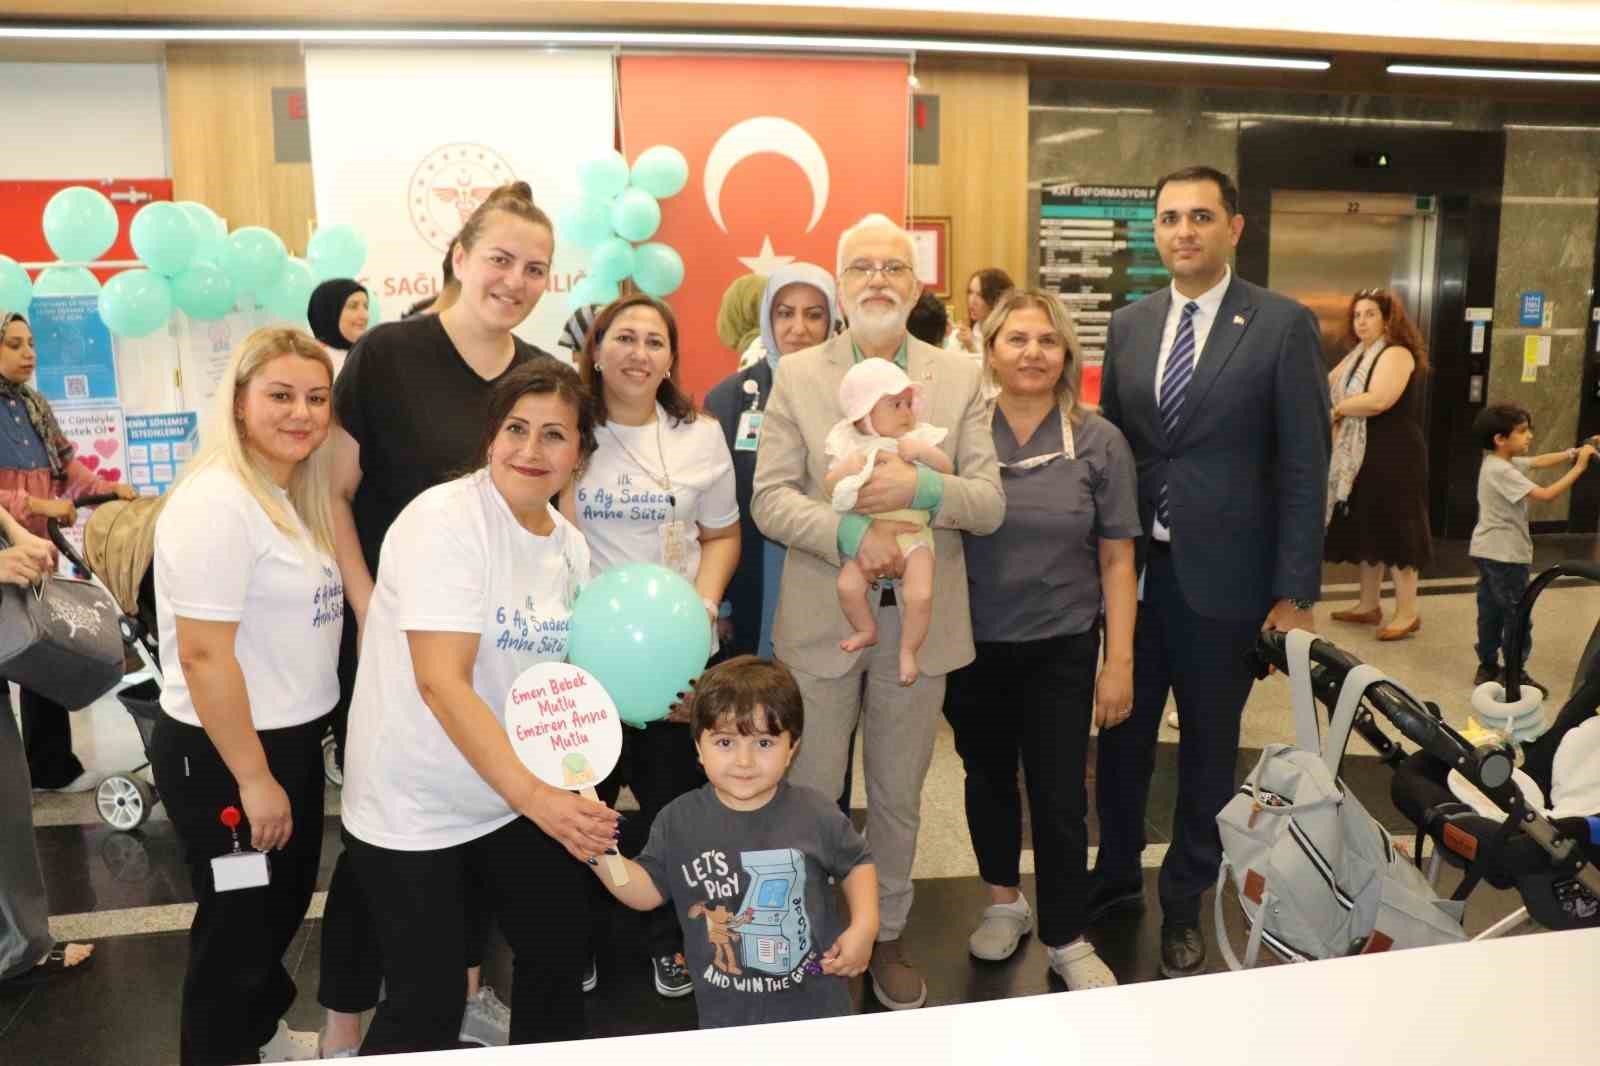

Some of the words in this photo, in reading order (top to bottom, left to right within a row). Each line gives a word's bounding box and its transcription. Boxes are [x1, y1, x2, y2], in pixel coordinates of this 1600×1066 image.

[384, 271, 437, 296] SAĞL
[63, 425, 91, 436] estek
[578, 488, 586, 502] 6
[594, 488, 613, 510] Ay
[583, 504, 624, 520] Anne
[630, 506, 666, 521] Sütü
[496, 606, 506, 625] 6
[496, 630, 534, 652] Anne
[511, 686, 547, 705] Emen
[548, 672, 588, 695] Bebek
[537, 696, 577, 717] Mutlu
[515, 719, 568, 741] Emziren
[571, 709, 608, 728] Anne
[549, 731, 589, 751] Mutlu
[681, 849, 729, 888] LET'S
[703, 964, 730, 988] AND
[733, 976, 764, 993] WIN
[764, 976, 791, 992] THE
